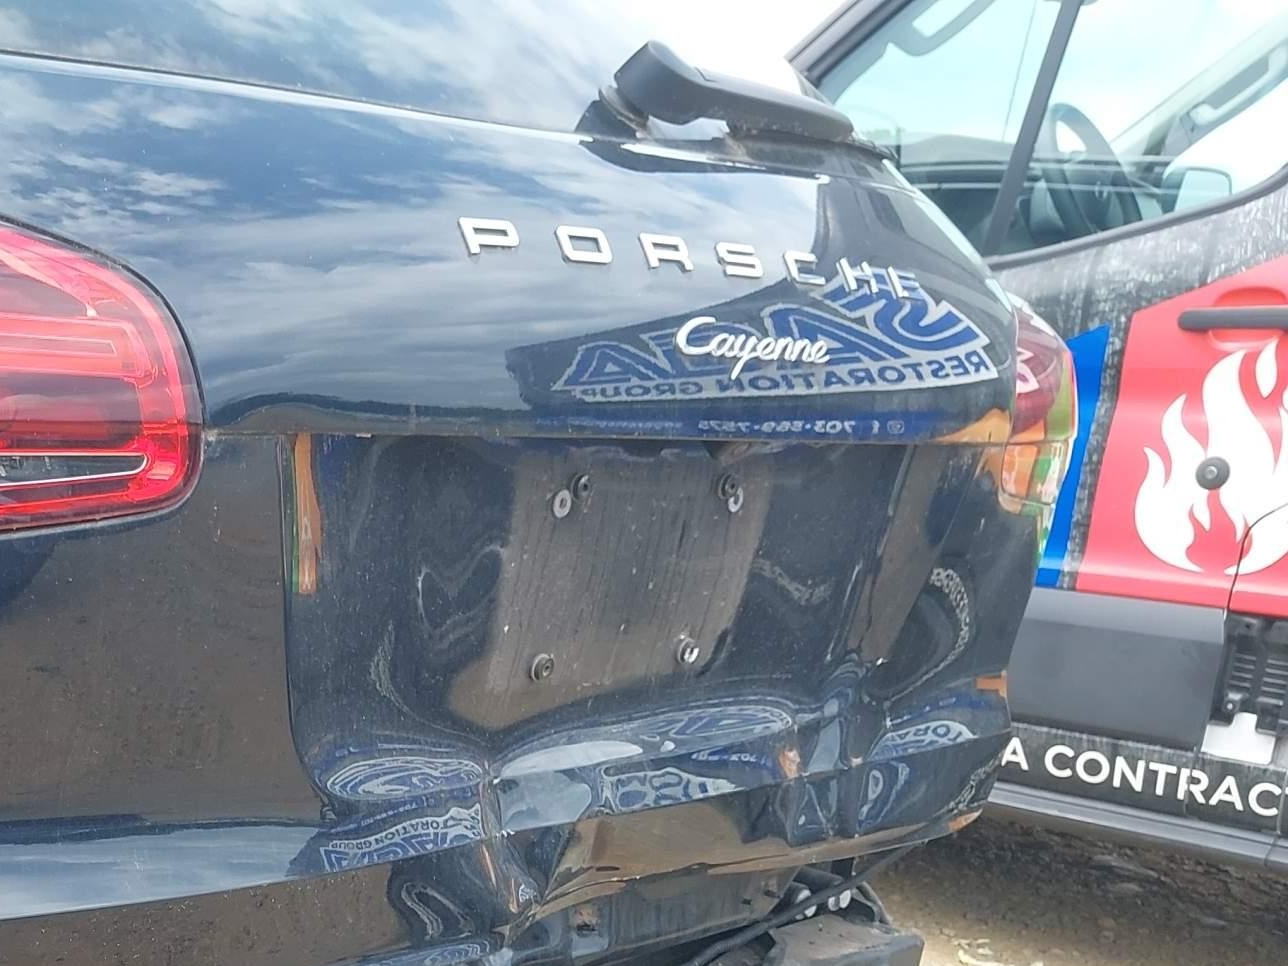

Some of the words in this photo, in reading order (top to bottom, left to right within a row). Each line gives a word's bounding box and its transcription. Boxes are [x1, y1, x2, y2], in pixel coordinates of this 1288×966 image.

[458, 216, 920, 299] PORSCHE
[675, 316, 831, 379] Cayenne
[1043, 744, 1288, 817] CONTRAC
